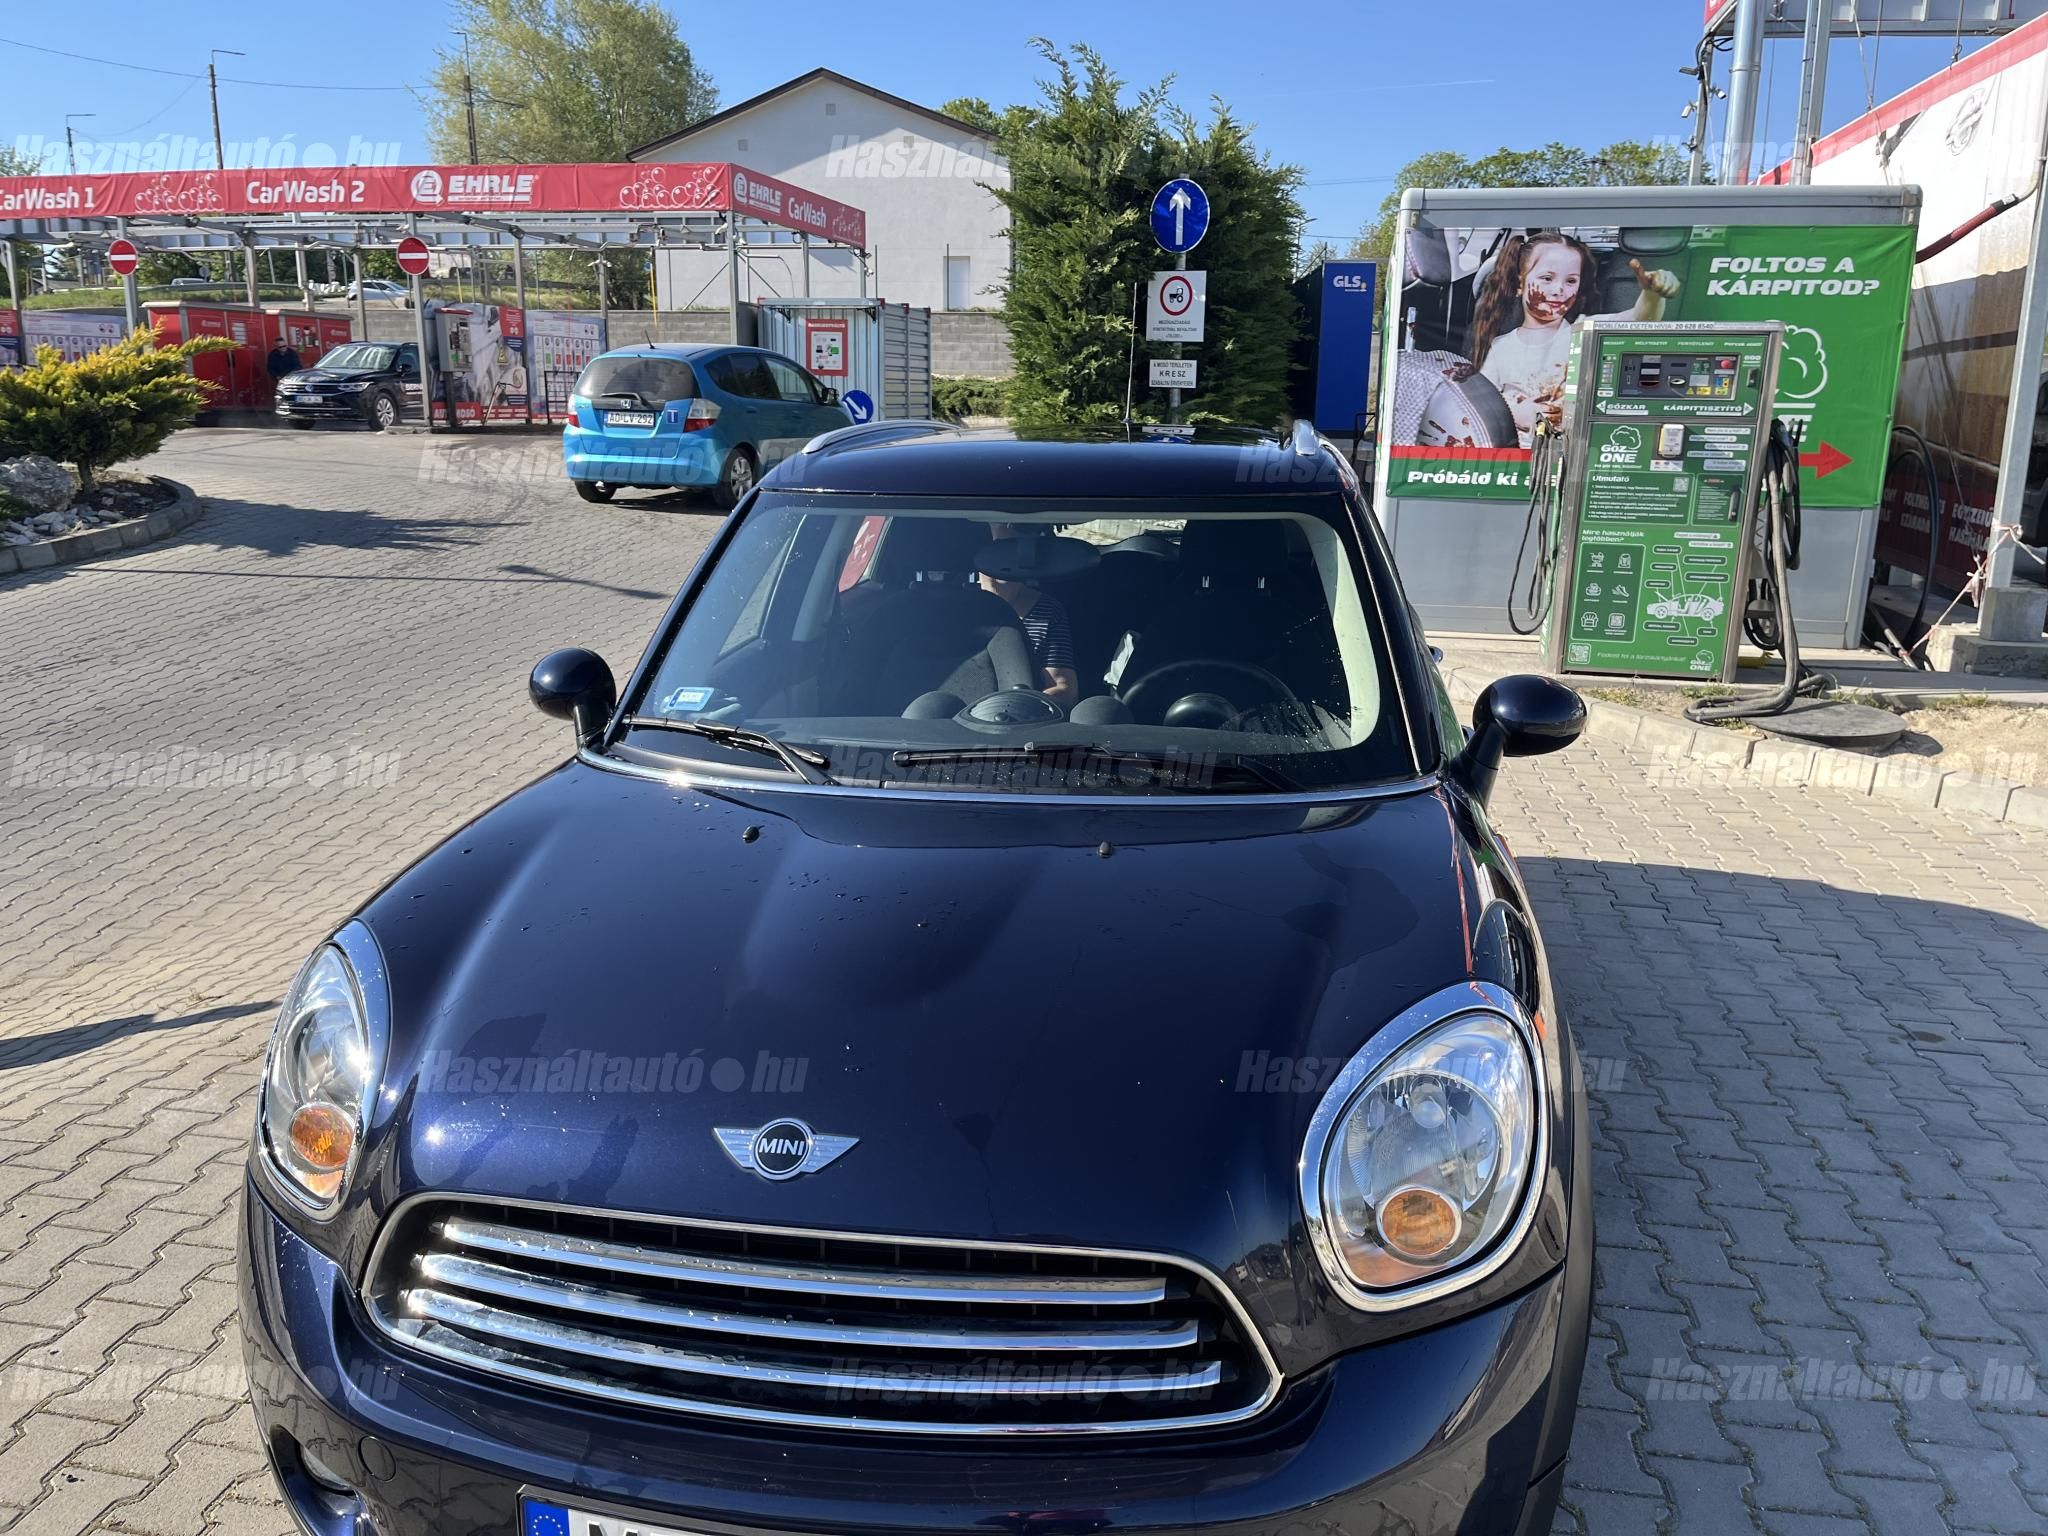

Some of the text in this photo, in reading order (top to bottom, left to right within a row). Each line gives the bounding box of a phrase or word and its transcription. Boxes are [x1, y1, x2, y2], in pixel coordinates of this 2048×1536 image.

[246, 179, 365, 204] CarWash 2
[448, 174, 533, 193] EHRLE
[750, 181, 782, 206] EHRLE
[85, 187, 95, 208] 1
[788, 197, 826, 228] CarWash
[1709, 257, 1855, 273] FOLTOS A
[1706, 275, 1880, 296] KÁRPITOD?
[1600, 453, 1637, 463] ONE
[1408, 469, 1491, 485] Próbáld
[1497, 471, 1517, 486] ki
[758, 1138, 804, 1155] MINI
